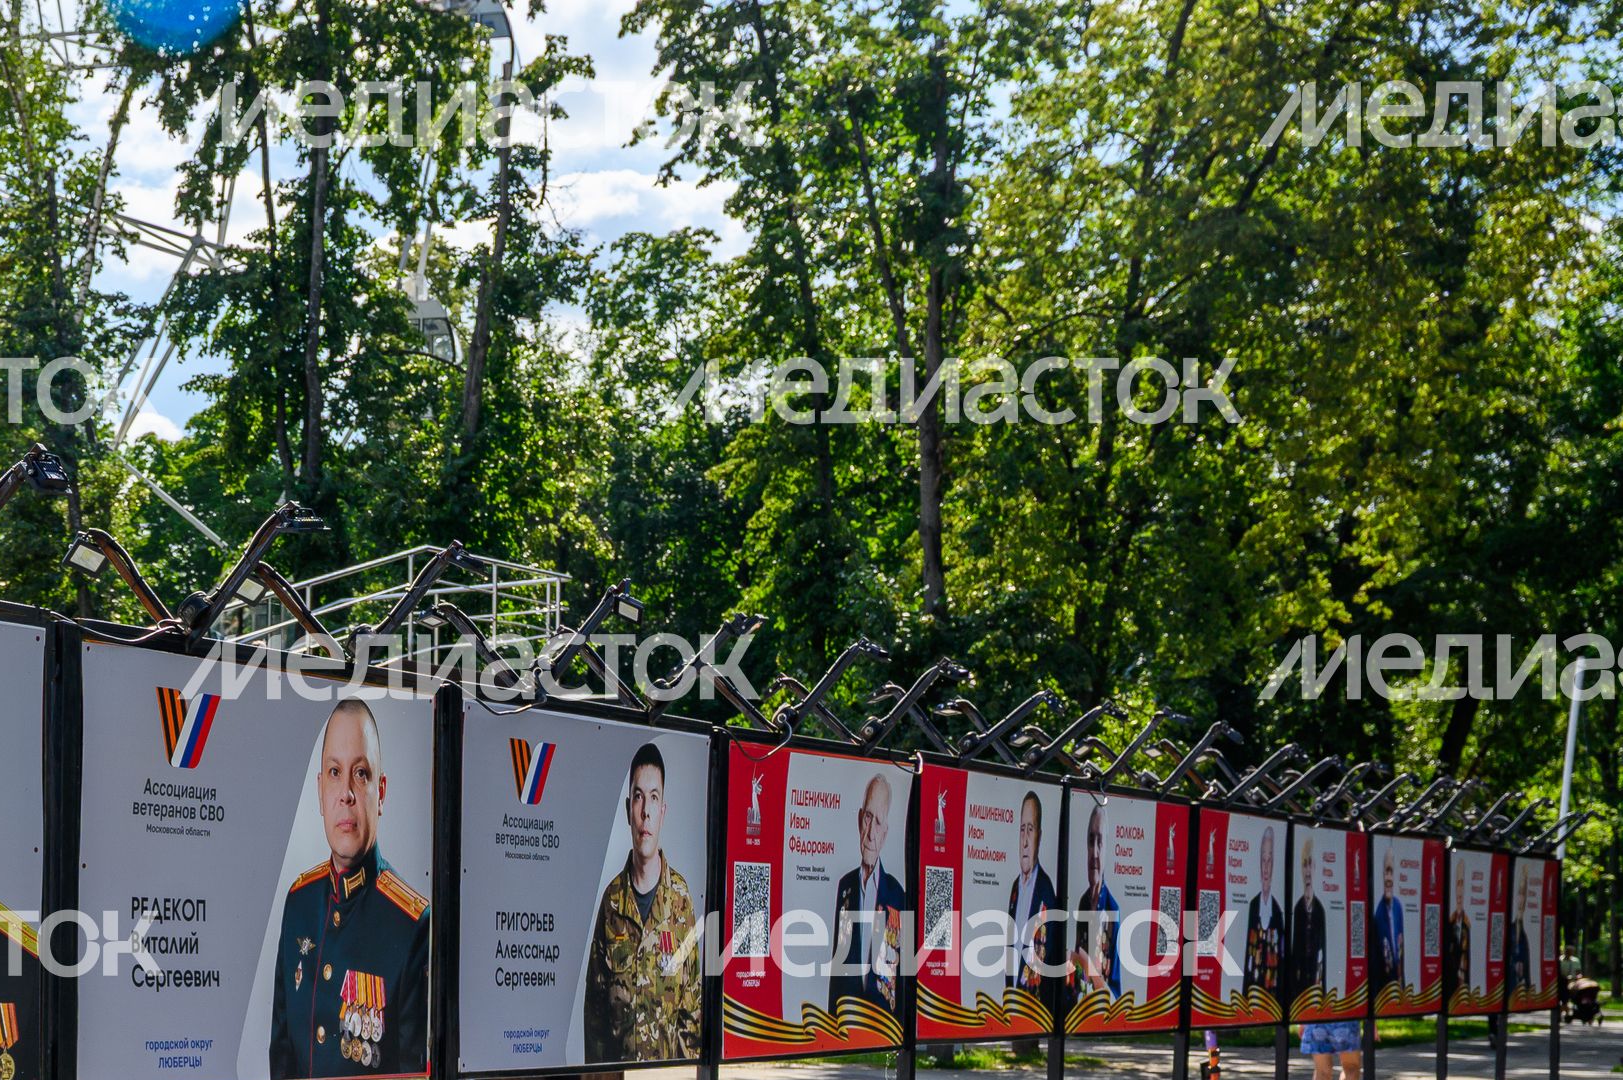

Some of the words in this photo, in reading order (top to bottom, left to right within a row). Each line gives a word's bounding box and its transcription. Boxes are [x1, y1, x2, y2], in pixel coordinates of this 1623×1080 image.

[143, 778, 217, 802] Ассоциация
[791, 788, 841, 810] ПШЕНИЧКИН
[132, 801, 196, 821] ветеранов
[199, 805, 225, 822] СВО
[789, 812, 810, 829] Иван
[146, 823, 184, 836] Московской
[185, 826, 211, 837] области
[502, 813, 554, 832] Ассоциация
[968, 825, 984, 840] Иван
[1115, 825, 1145, 840] ВОЛКОВА
[495, 832, 540, 849] ветеранов
[541, 834, 560, 849] СВО
[788, 835, 835, 856] Фёдорович
[1114, 843, 1133, 857] Ольга
[967, 845, 1007, 862] Михайлович
[131, 896, 206, 924] РЕДЕКОП
[495, 911, 555, 932] ГРИГОРЬЕВ
[131, 930, 199, 954] Виталий
[495, 939, 560, 963] Александр
[131, 964, 220, 992] Сергеевич
[495, 966, 556, 991] Сергеевич
[145, 1037, 189, 1052] городской
[190, 1038, 214, 1051] округ
[158, 1055, 202, 1069] ЛЮБЕРЦЫ
